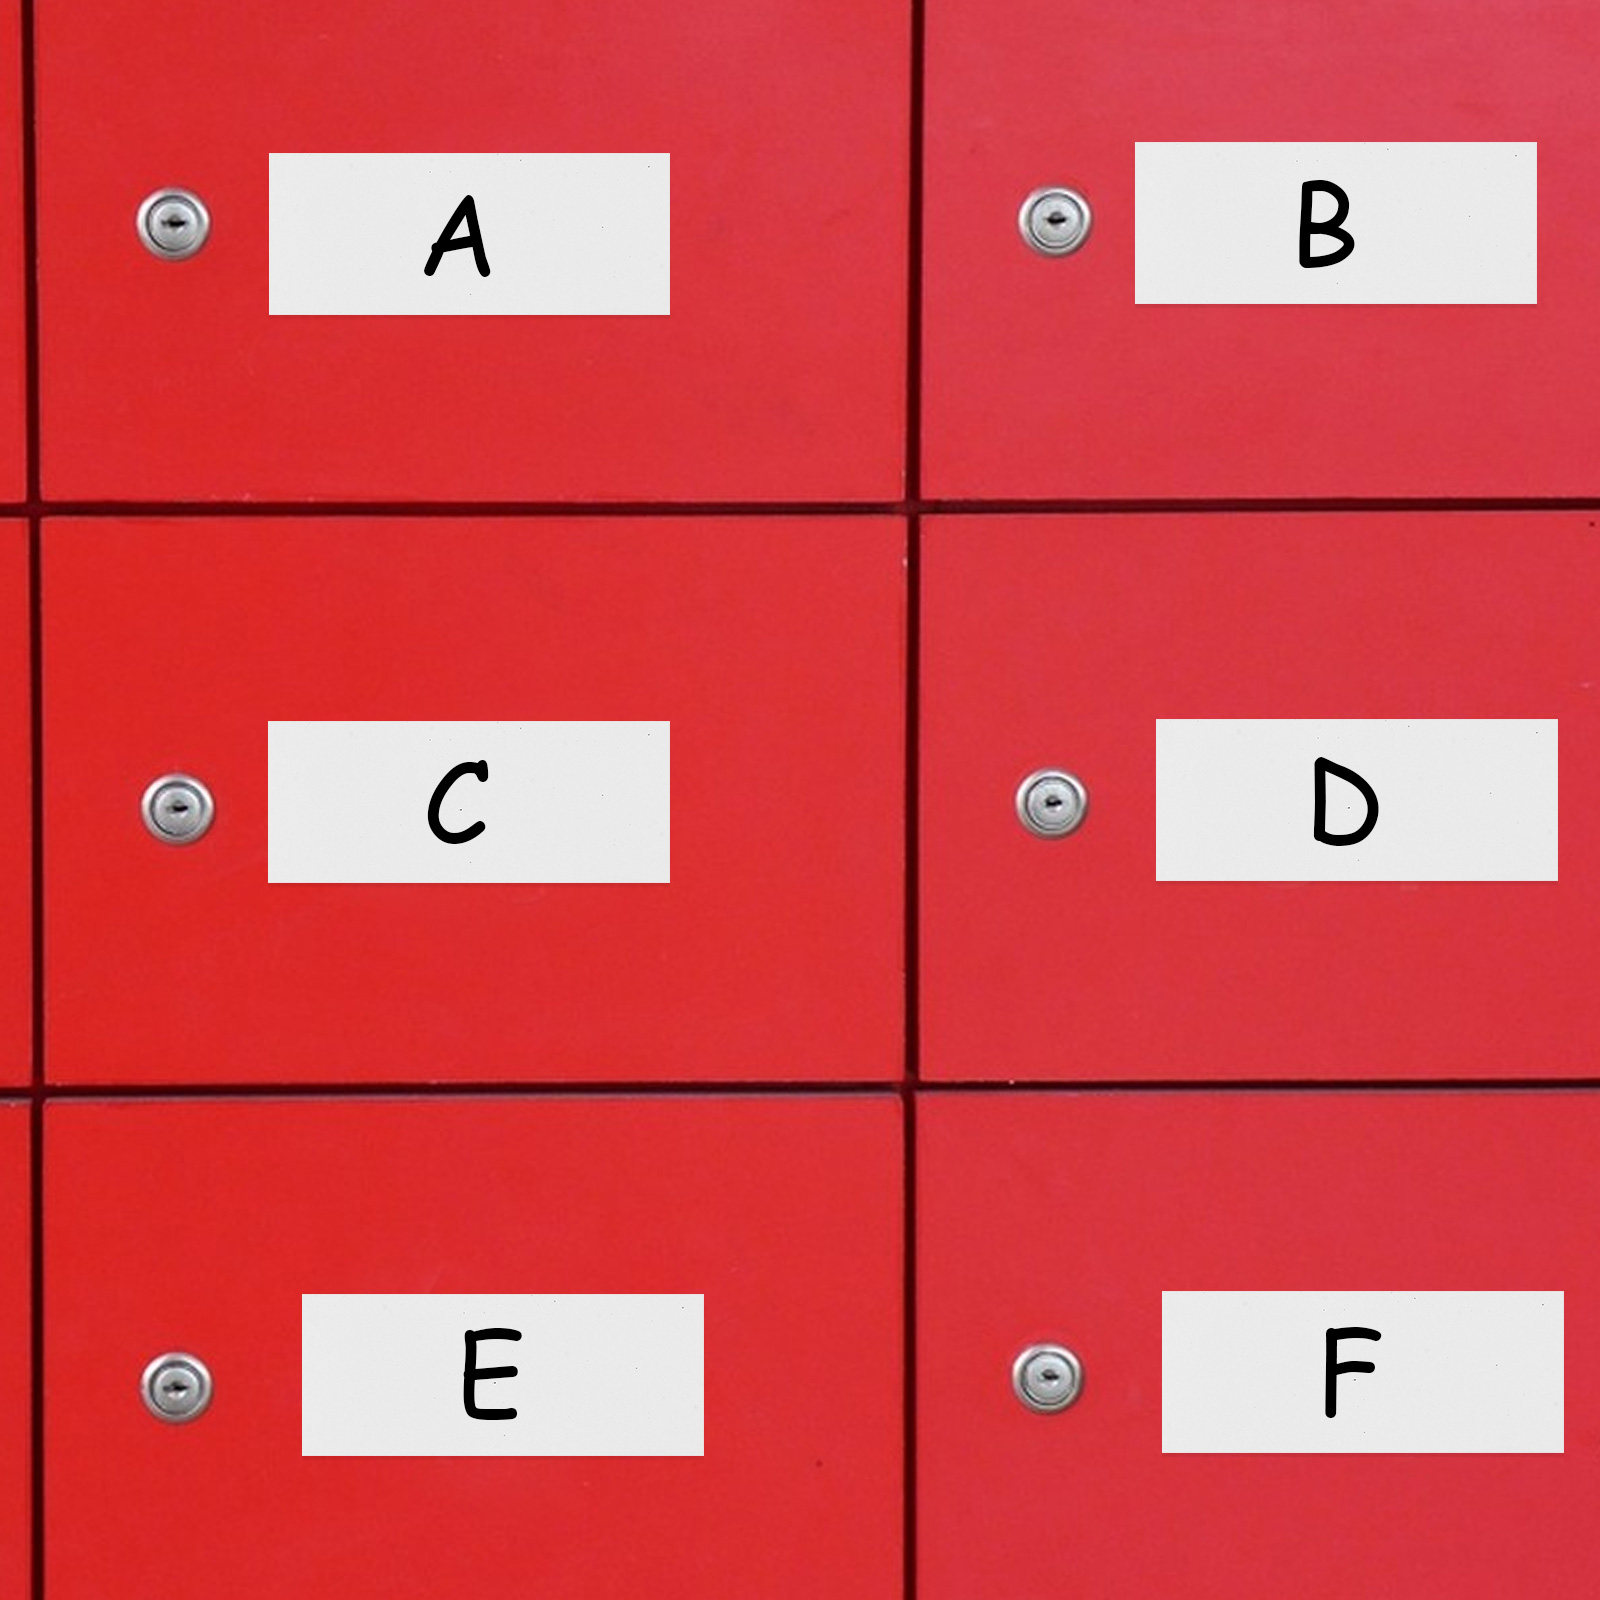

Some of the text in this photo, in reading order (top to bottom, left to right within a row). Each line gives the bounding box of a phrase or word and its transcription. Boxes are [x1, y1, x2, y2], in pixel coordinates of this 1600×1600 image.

[424, 195, 490, 277] A
[1299, 180, 1354, 268] B
[428, 760, 488, 844] C
[1314, 757, 1378, 846] D
[464, 1328, 522, 1420] E
[1325, 1327, 1381, 1418] F
